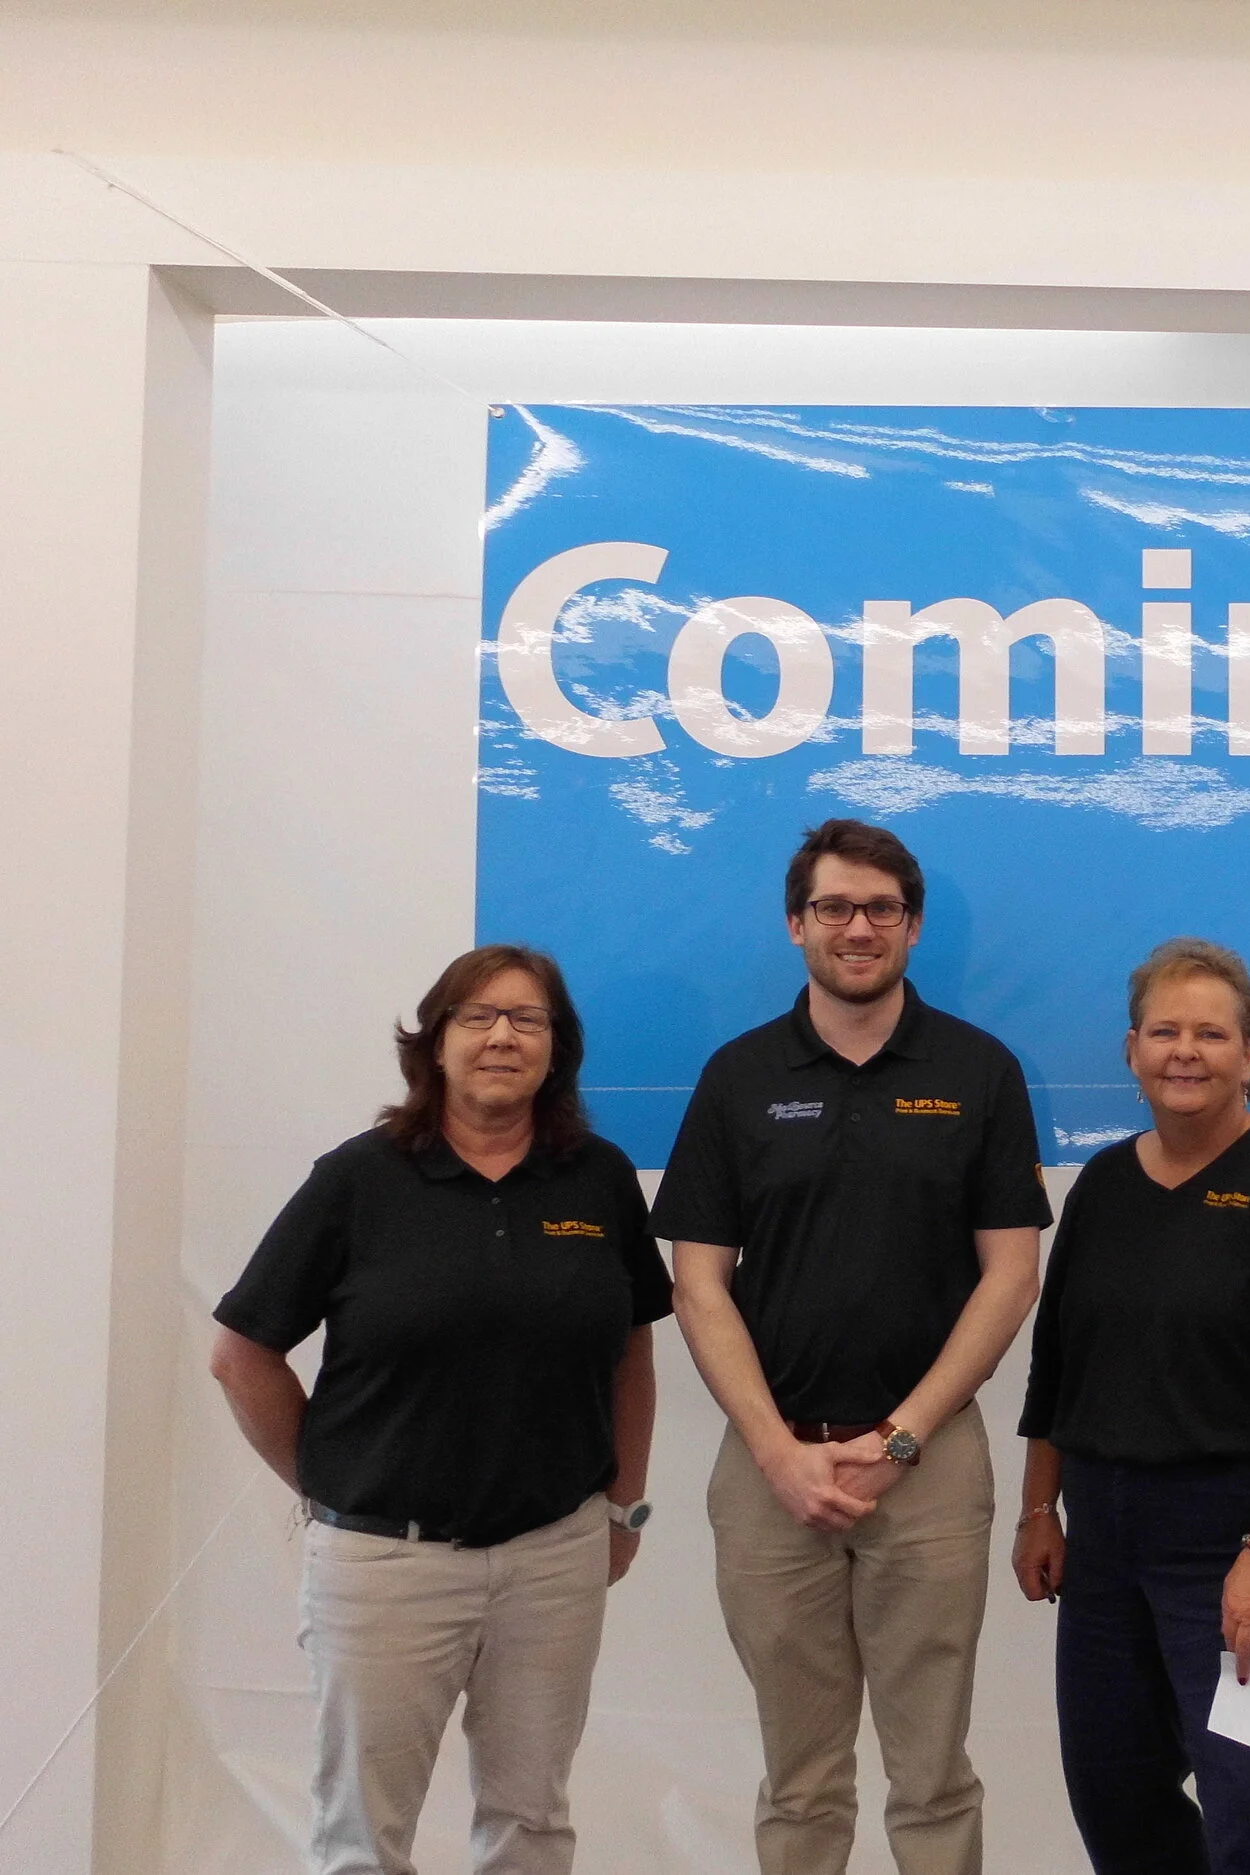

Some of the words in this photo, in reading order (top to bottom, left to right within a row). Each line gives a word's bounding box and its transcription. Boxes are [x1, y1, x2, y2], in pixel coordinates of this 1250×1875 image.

[895, 1098, 913, 1108] The
[914, 1099, 933, 1108] UPS
[934, 1098, 959, 1110] Store
[542, 1220, 559, 1230] The
[560, 1220, 579, 1230] UPS
